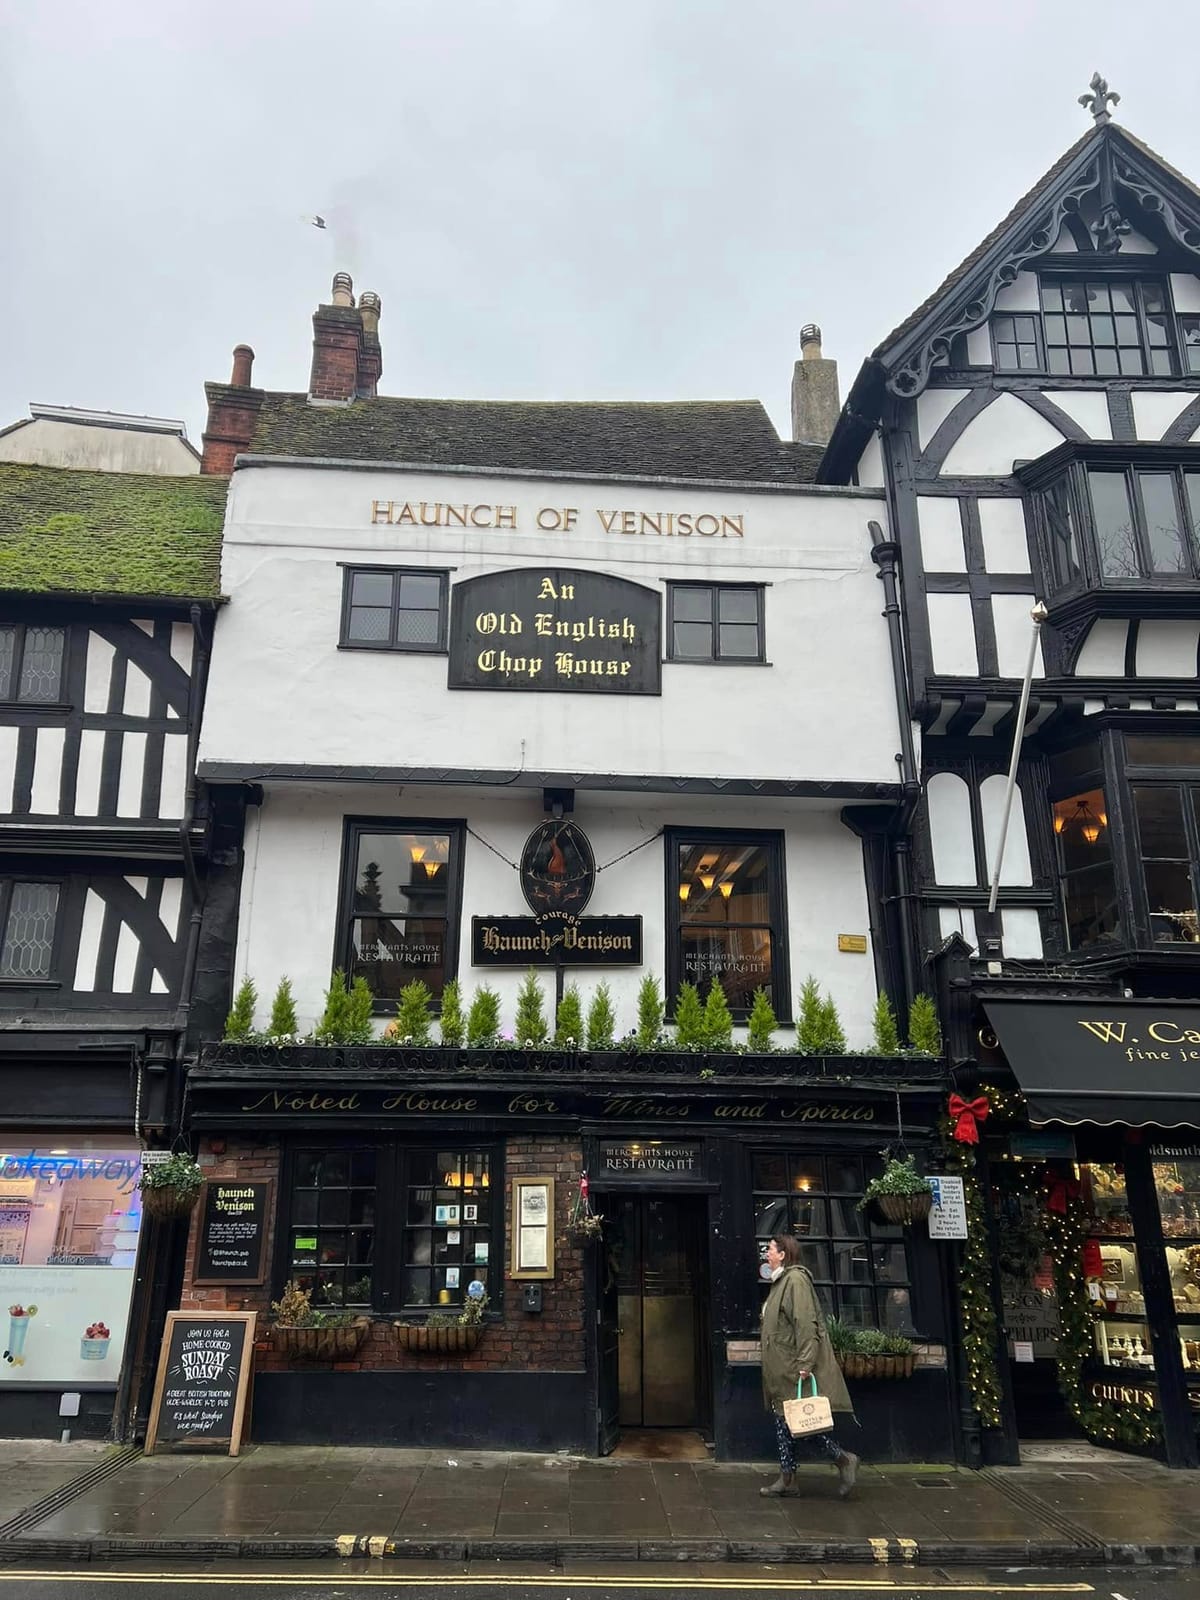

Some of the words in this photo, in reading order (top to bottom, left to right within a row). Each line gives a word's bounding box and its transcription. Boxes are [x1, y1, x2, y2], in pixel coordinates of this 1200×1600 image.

[371, 500, 517, 528] HAUNCH
[537, 507, 580, 532] OF
[597, 509, 745, 538] VENISON
[537, 577, 575, 600] An
[476, 612, 523, 634] Old
[535, 613, 636, 643] English
[478, 650, 543, 678] Chop
[555, 652, 632, 678] House
[412, 944, 441, 952] HOUSE
[481, 926, 551, 955] Haunch
[563, 926, 633, 953] Venison
[357, 951, 441, 963] RESTAURANT
[685, 960, 767, 975] RESTAURANT
[1077, 1021, 1140, 1043] W.
[1125, 1047, 1171, 1062] fine
[241, 1090, 361, 1111] Noted
[382, 1091, 479, 1112] House
[508, 1094, 559, 1113] for
[602, 1098, 690, 1116] Wines
[714, 1102, 768, 1118] and
[781, 1100, 875, 1121] Spirits
[664, 1149, 695, 1157] HOUSE
[606, 1156, 695, 1171] RESTAURANT
[218, 1187, 255, 1200] Haunch
[215, 1200, 255, 1211] Venison
[181, 1350, 231, 1368] SUNDAY
[184, 1364, 224, 1381] ROAST
